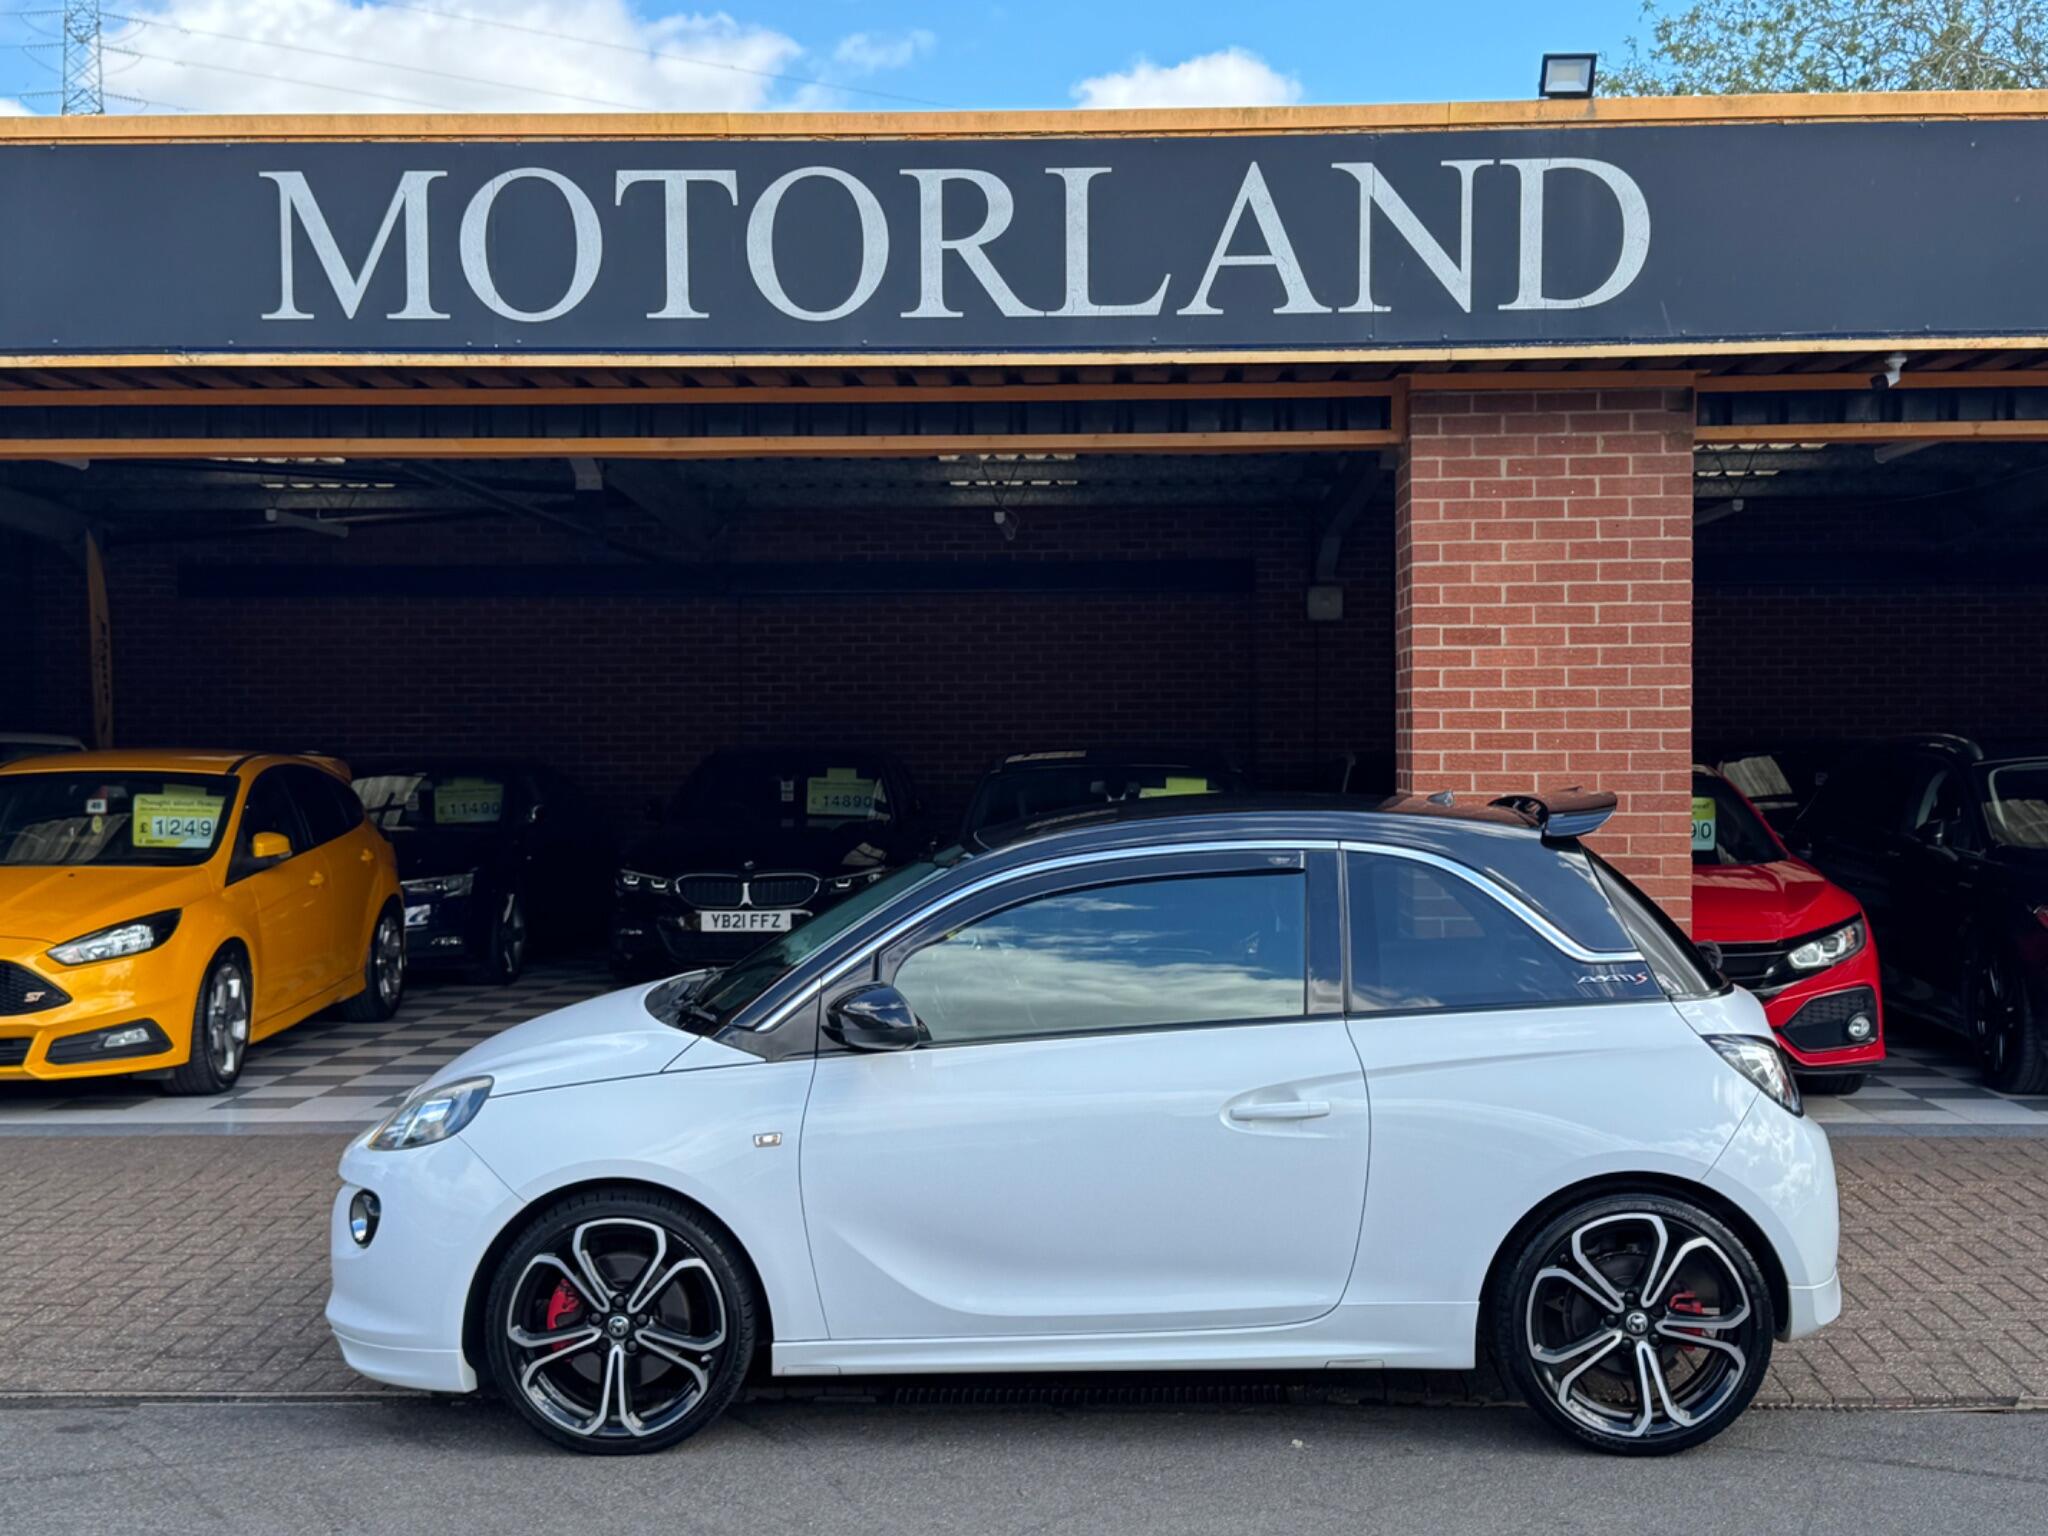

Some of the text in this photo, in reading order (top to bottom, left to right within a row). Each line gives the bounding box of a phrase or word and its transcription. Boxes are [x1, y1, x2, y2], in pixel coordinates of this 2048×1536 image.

[258, 158, 1652, 323] MOTORLAND
[711, 914, 781, 929] YB21 FFZ
[24, 991, 46, 1003] ST
